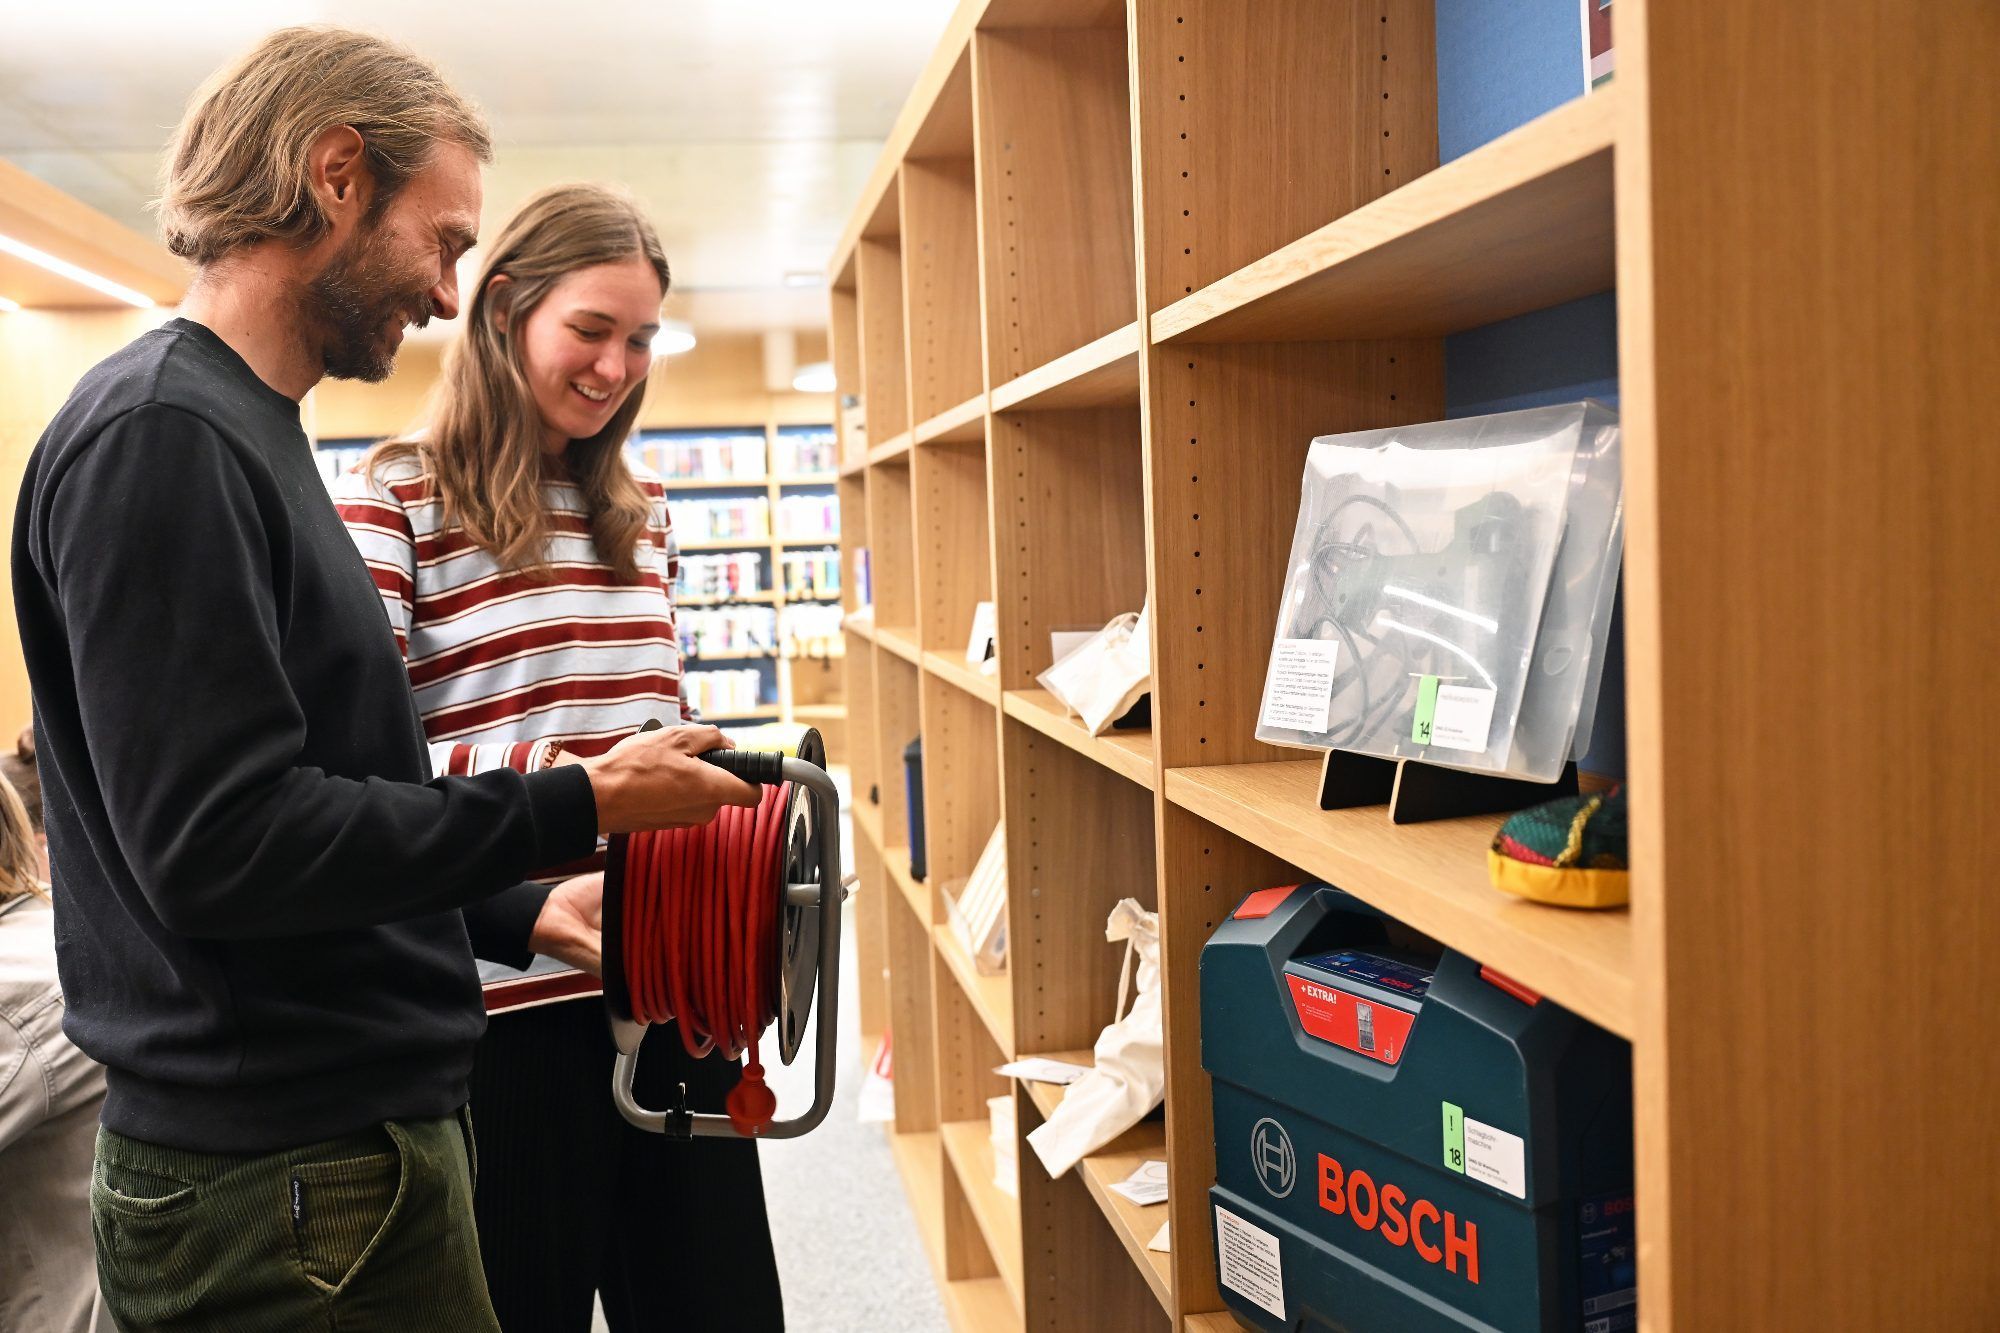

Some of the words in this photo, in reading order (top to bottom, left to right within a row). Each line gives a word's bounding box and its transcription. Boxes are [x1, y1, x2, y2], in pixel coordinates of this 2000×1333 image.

[1420, 720, 1431, 738] 14
[1307, 985, 1337, 1004] EXTRA!
[1449, 1147, 1462, 1167] 18
[1604, 1198, 1634, 1216] BOS
[1317, 1152, 1480, 1286] BOSCH
